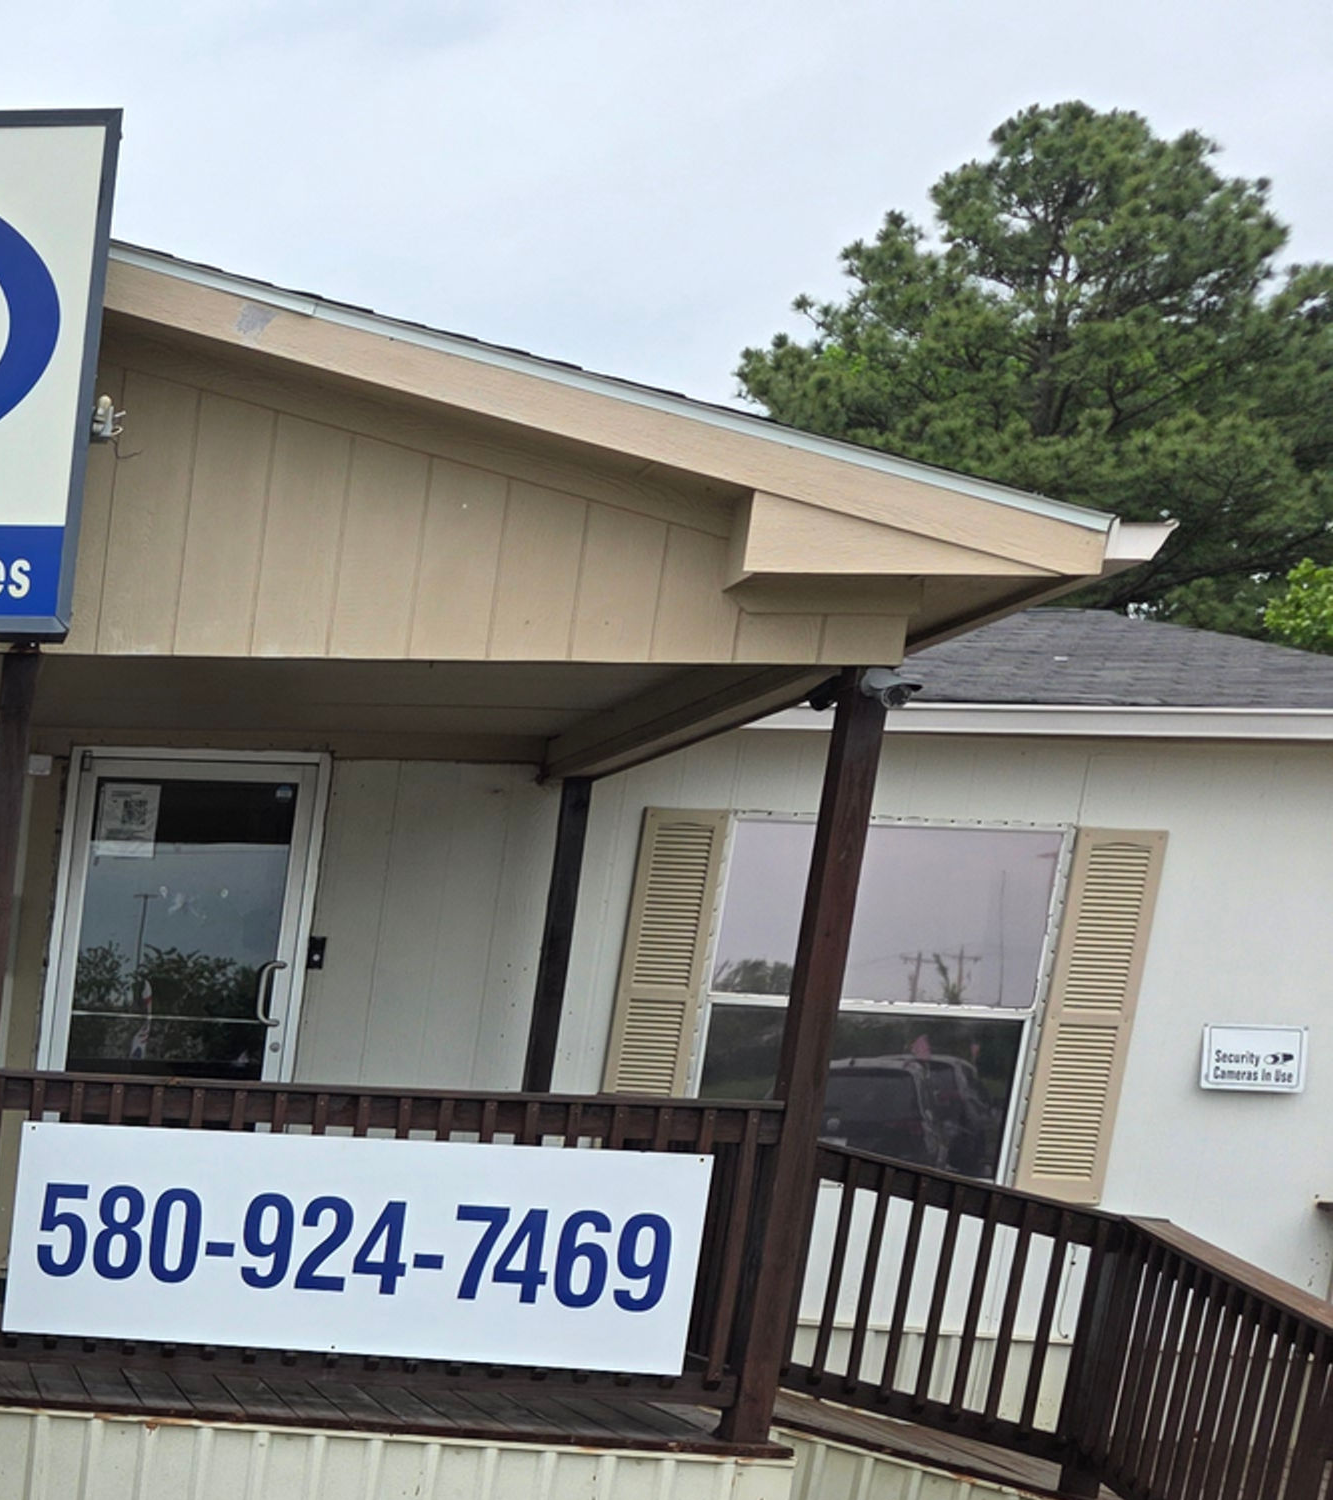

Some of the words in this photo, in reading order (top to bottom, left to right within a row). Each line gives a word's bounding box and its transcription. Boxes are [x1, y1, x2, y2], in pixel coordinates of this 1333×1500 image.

[1214, 1049, 1261, 1067] Security
[1213, 1065, 1258, 1082] Cameras
[1261, 1068, 1272, 1082] In
[1274, 1069, 1294, 1083] Use
[35, 1181, 673, 1313] 580-924-7469
